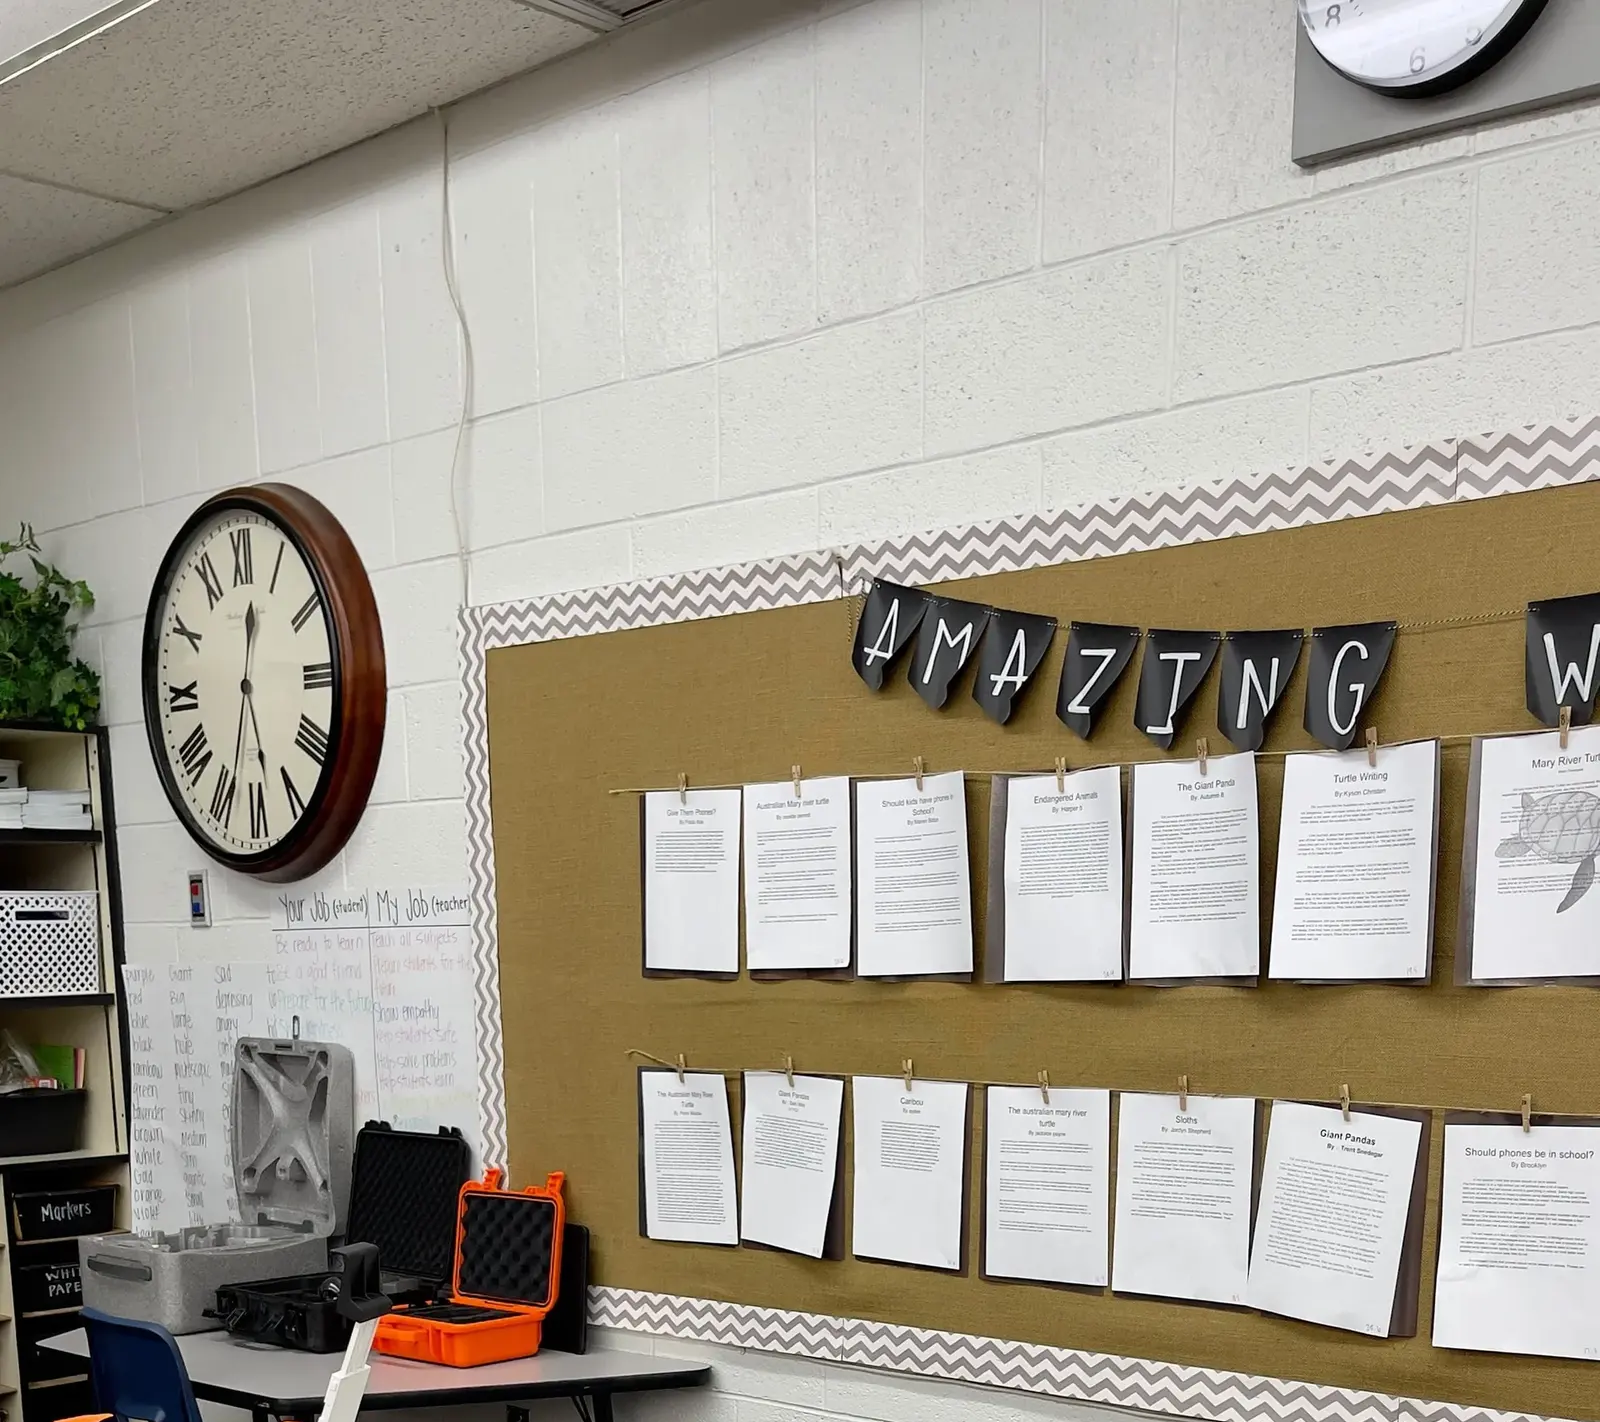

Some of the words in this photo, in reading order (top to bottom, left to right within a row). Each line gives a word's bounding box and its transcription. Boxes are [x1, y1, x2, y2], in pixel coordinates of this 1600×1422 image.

[229, 528, 254, 588] XII
[194, 552, 224, 612] XI
[291, 591, 321, 633] II
[173, 613, 202, 654] X
[863, 598, 1370, 736] AMAZING
[303, 662, 332, 690] III
[169, 680, 199, 712] IX
[179, 722, 213, 788] VIII
[1532, 759, 1555, 770] Mary
[1558, 756, 1582, 766] River
[1177, 783, 1193, 792] The
[1194, 781, 1214, 790] Giant
[1215, 779, 1236, 788] Panda
[1333, 774, 1357, 784] Turtle
[1360, 772, 1388, 782] Writing
[210, 764, 236, 831] VII
[756, 801, 786, 810] Australian
[787, 800, 802, 809] Mary
[815, 797, 830, 805] turtle
[882, 799, 905, 808] Should
[906, 798, 918, 806] kids
[919, 796, 932, 804] have
[1034, 794, 1073, 805] Endangered
[1075, 791, 1098, 800] Animals
[248, 781, 269, 839] VI
[680, 808, 694, 816] Them
[912, 807, 935, 817] School?
[278, 892, 305, 928] Your
[309, 891, 331, 922] Job
[332, 894, 369, 920] (student)
[376, 890, 399, 925] My
[405, 888, 429, 922] Job
[399, 931, 411, 947] all
[292, 935, 319, 962] ready
[900, 1097, 924, 1106] Caribou
[1008, 1107, 1021, 1115] The
[1022, 1108, 1054, 1116] australian
[1055, 1110, 1071, 1118] mary
[1072, 1109, 1088, 1117] river
[1175, 1115, 1198, 1125] Sloths
[1039, 1120, 1056, 1128] turtle
[1320, 1128, 1343, 1141] Giant
[1344, 1133, 1376, 1146] Pandas
[1465, 1147, 1497, 1157] Should
[1499, 1148, 1532, 1159] phones
[1534, 1149, 1546, 1158] be
[1548, 1149, 1557, 1158] in
[1559, 1150, 1594, 1159] school?
[1511, 1161, 1519, 1169] By
[1520, 1162, 1547, 1170] Brooklyn
[41, 1201, 92, 1222] Markers
[45, 1267, 81, 1281] WHIT
[48, 1281, 82, 1297] PAPE
